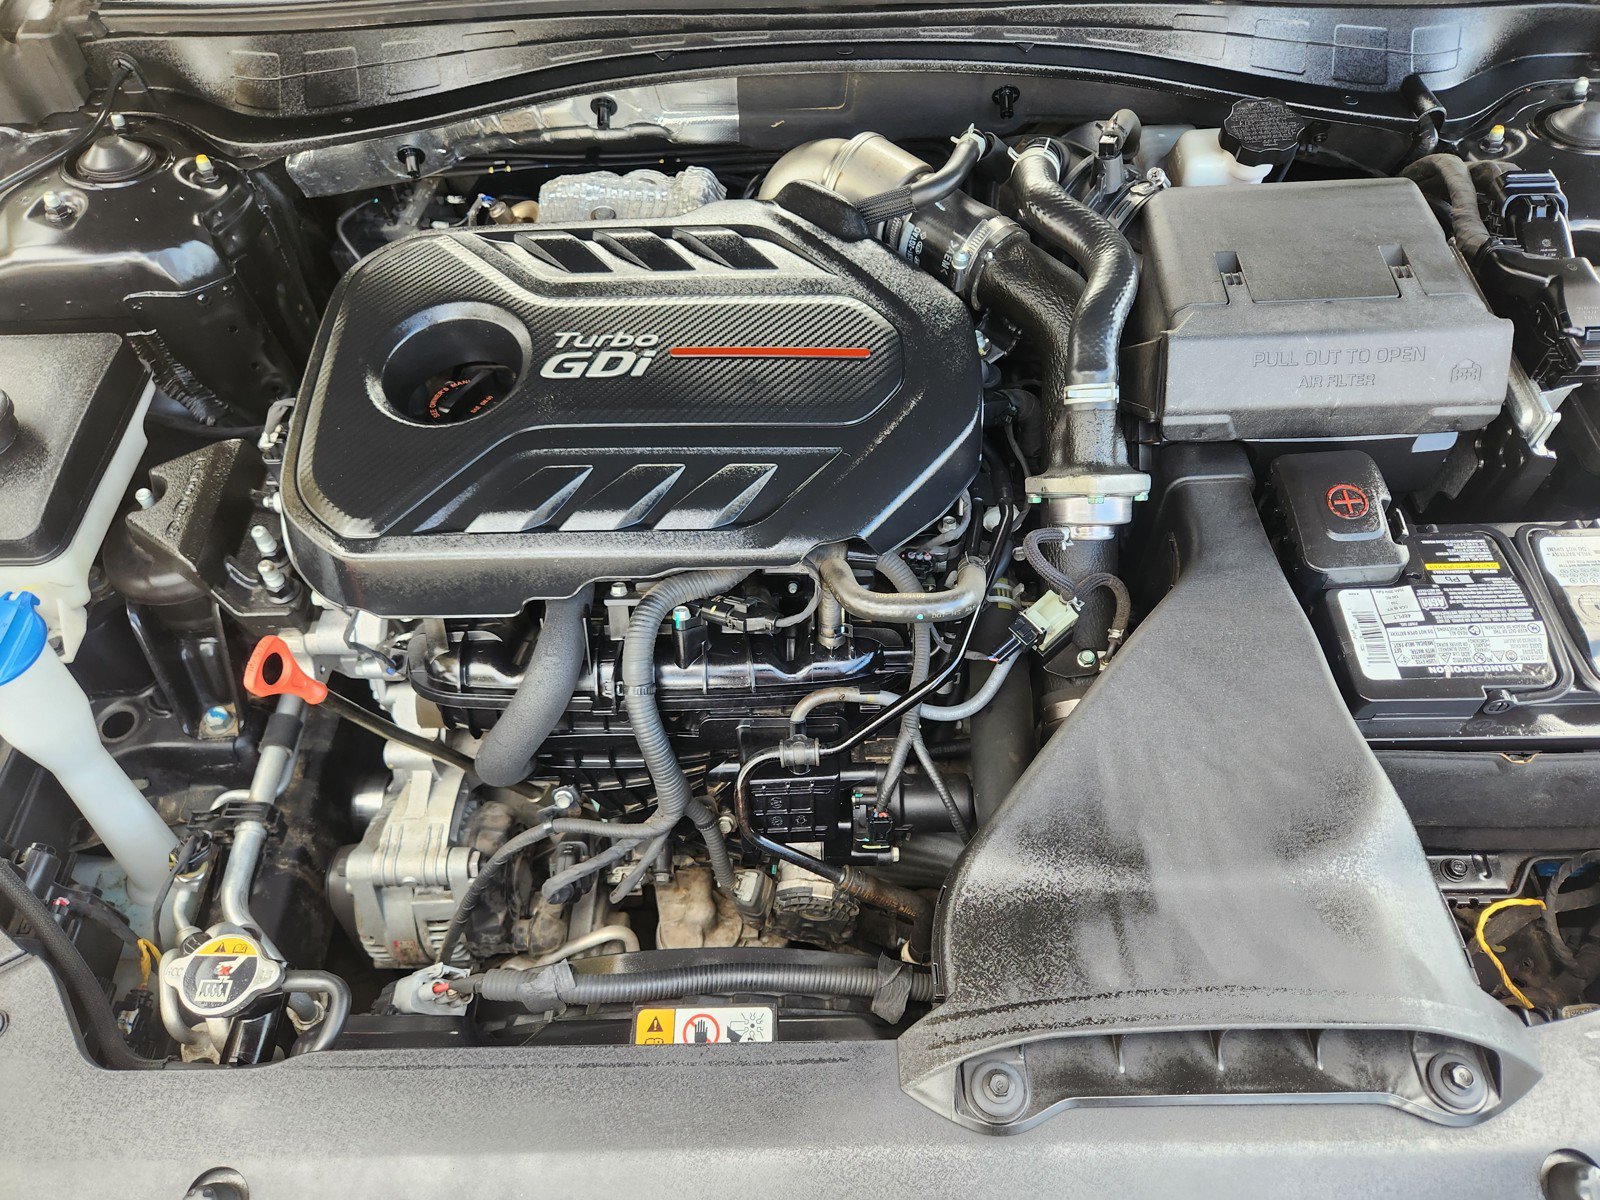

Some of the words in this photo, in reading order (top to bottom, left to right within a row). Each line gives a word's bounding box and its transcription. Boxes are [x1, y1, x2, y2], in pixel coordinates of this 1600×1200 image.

[555, 331, 659, 348] Turbo
[540, 350, 658, 379] GDi
[1252, 351, 1298, 368] PULL
[1305, 349, 1341, 366] OUT
[1346, 348, 1371, 364] TO
[1377, 346, 1426, 363] OPEN
[1297, 375, 1323, 389] AIR
[1327, 373, 1376, 387] FILTER
[430, 408, 440, 419] SEE
[1421, 597, 1445, 606] AGM
